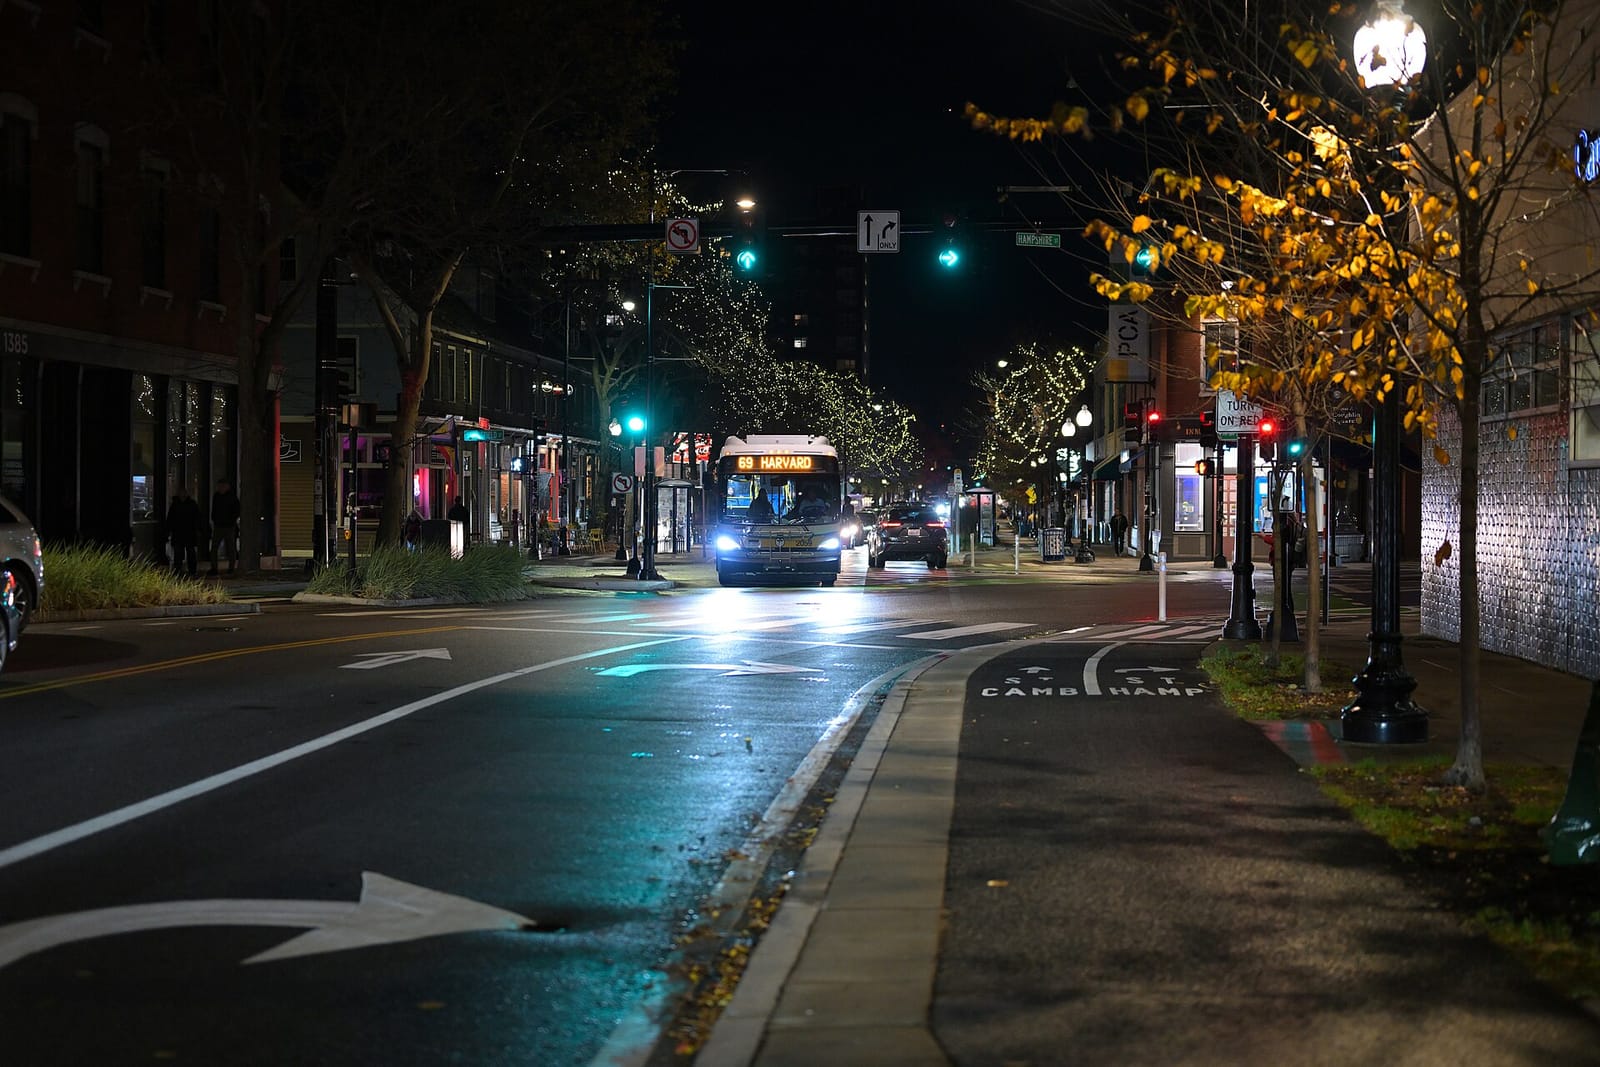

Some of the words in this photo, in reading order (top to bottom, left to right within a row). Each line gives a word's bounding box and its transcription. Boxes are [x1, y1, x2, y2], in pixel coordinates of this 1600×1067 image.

[880, 241, 897, 249] ONLY
[1018, 234, 1053, 246] HAMPSHIRE
[1118, 310, 1138, 356] PCA
[3, 332, 28, 355] 1385
[1227, 401, 1254, 411] TURN
[1220, 415, 1235, 426] ON
[1240, 415, 1260, 426] RED
[737, 456, 754, 469] 69
[761, 456, 812, 469] HARVARD
[1004, 676, 1054, 685] ST
[1126, 676, 1176, 685] ST
[981, 687, 1079, 697] CAMB
[1109, 687, 1204, 697] HAMP
